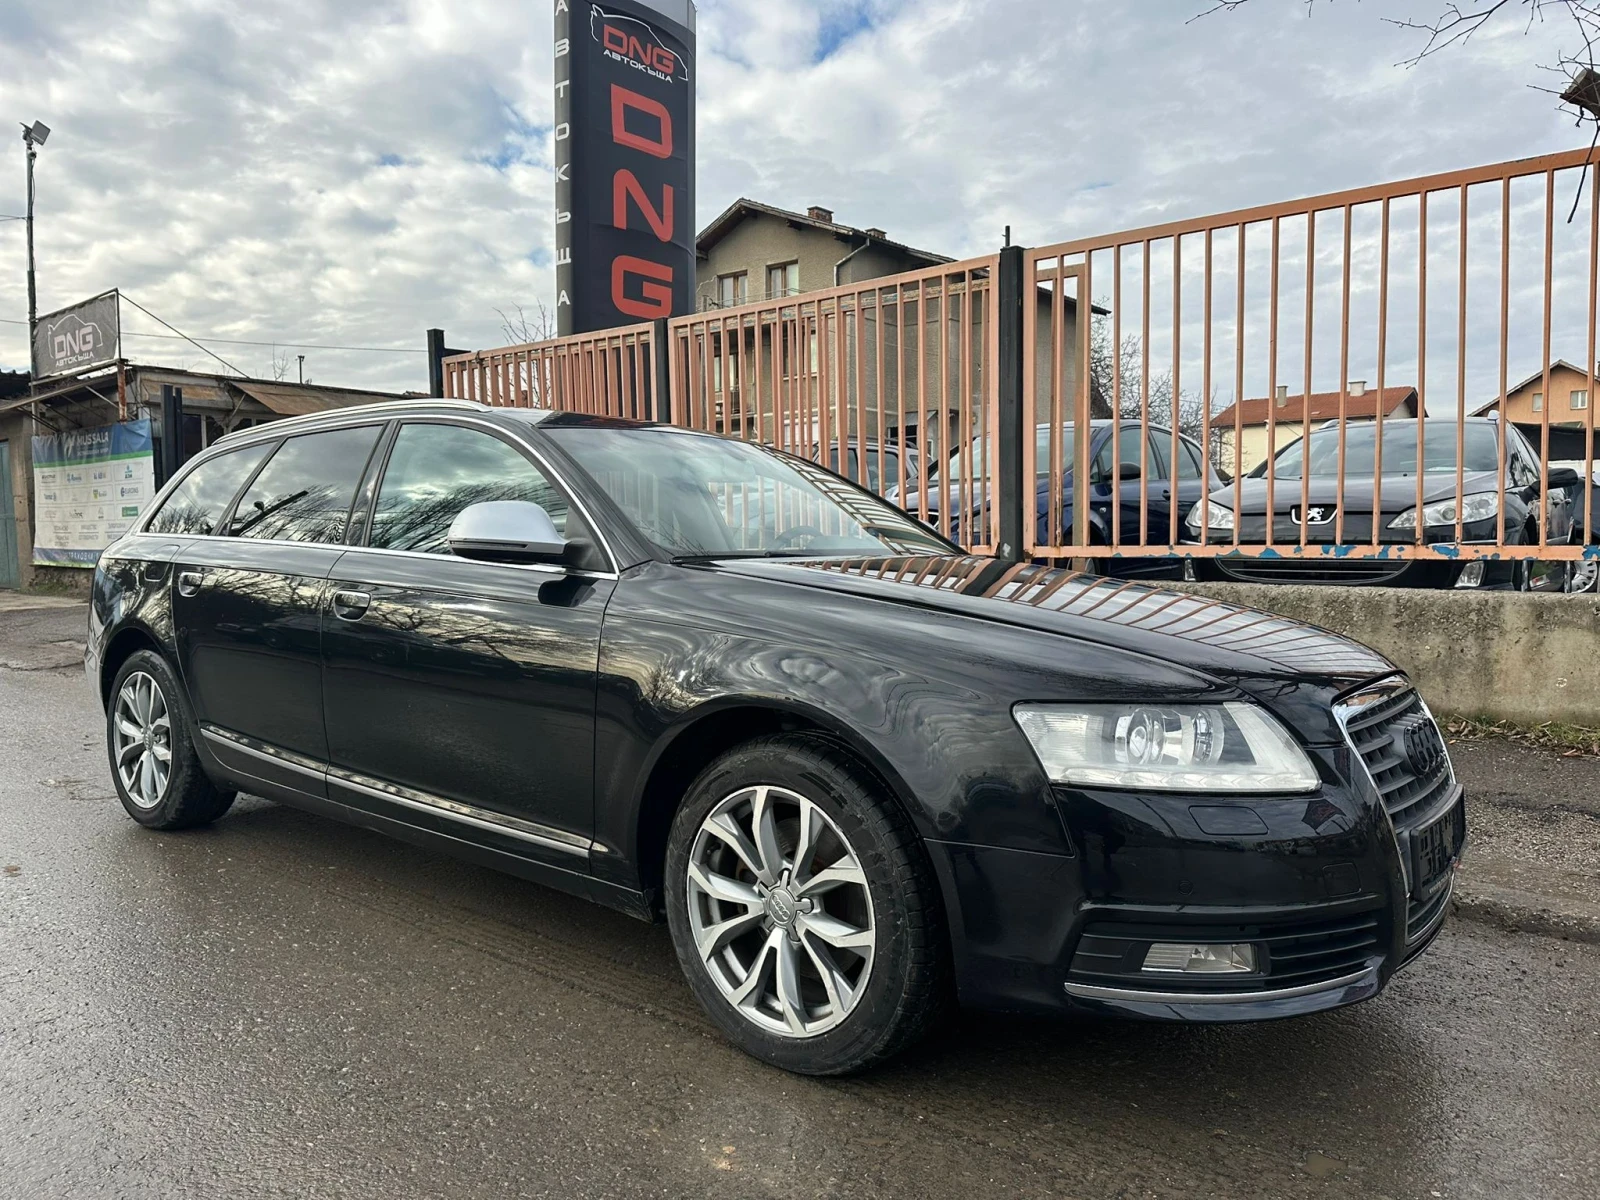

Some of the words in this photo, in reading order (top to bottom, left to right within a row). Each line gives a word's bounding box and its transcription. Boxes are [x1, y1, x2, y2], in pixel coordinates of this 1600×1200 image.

[603, 24, 675, 75] DNG
[611, 83, 673, 320] DNG
[54, 325, 93, 359] DNG
[77, 431, 109, 445] MUSSALA
